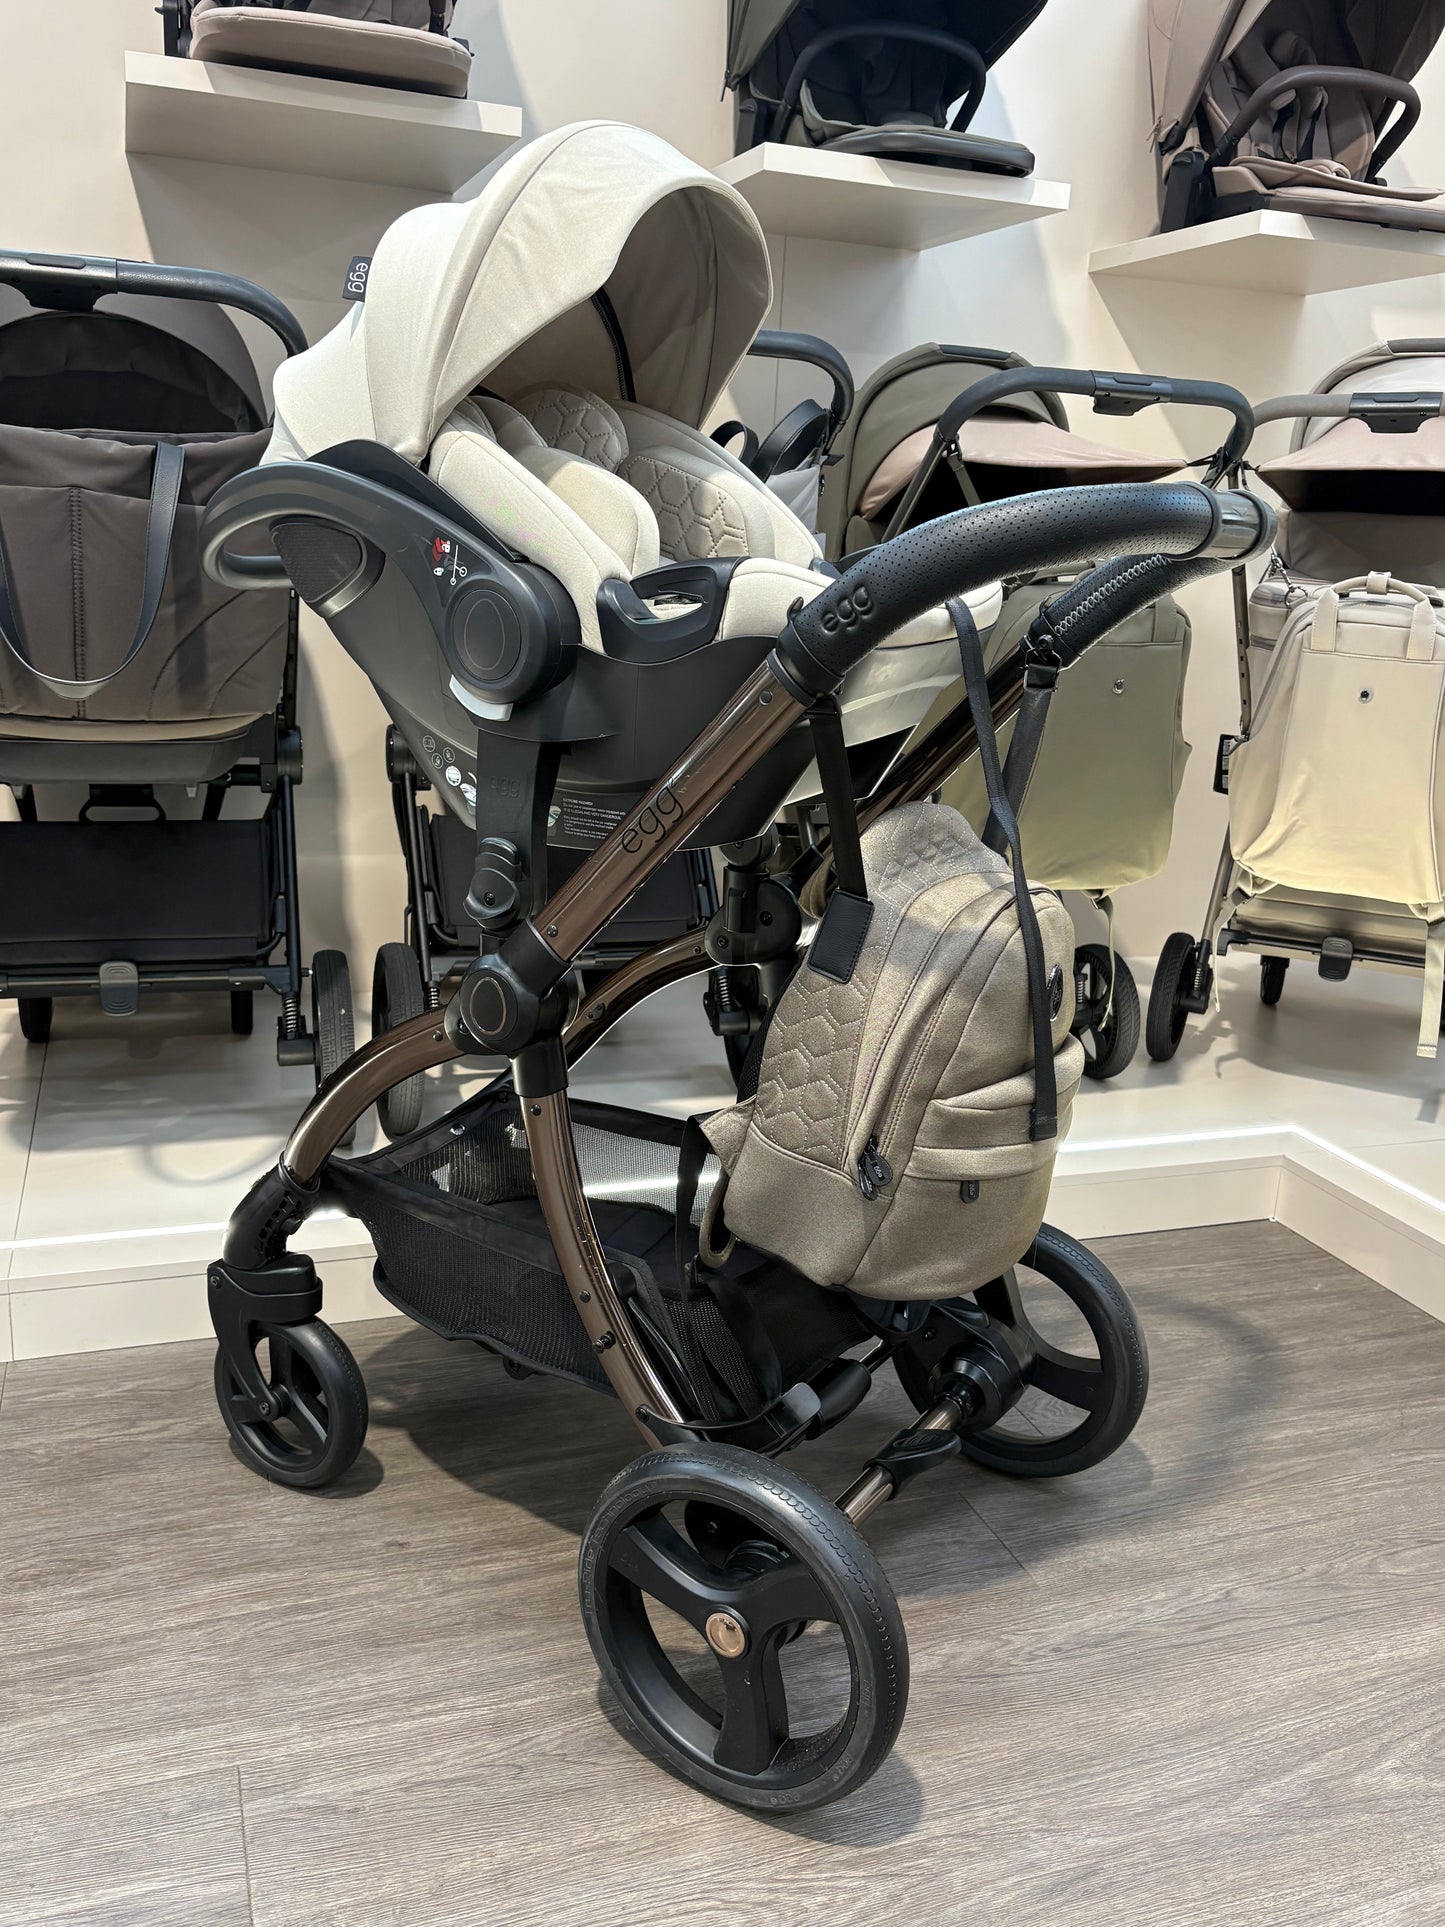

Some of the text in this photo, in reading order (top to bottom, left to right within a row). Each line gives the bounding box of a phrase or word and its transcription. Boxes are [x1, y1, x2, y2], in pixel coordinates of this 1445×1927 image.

[347, 262, 369, 293] egg
[820, 583, 874, 635] egg
[620, 783, 685, 854] egg
